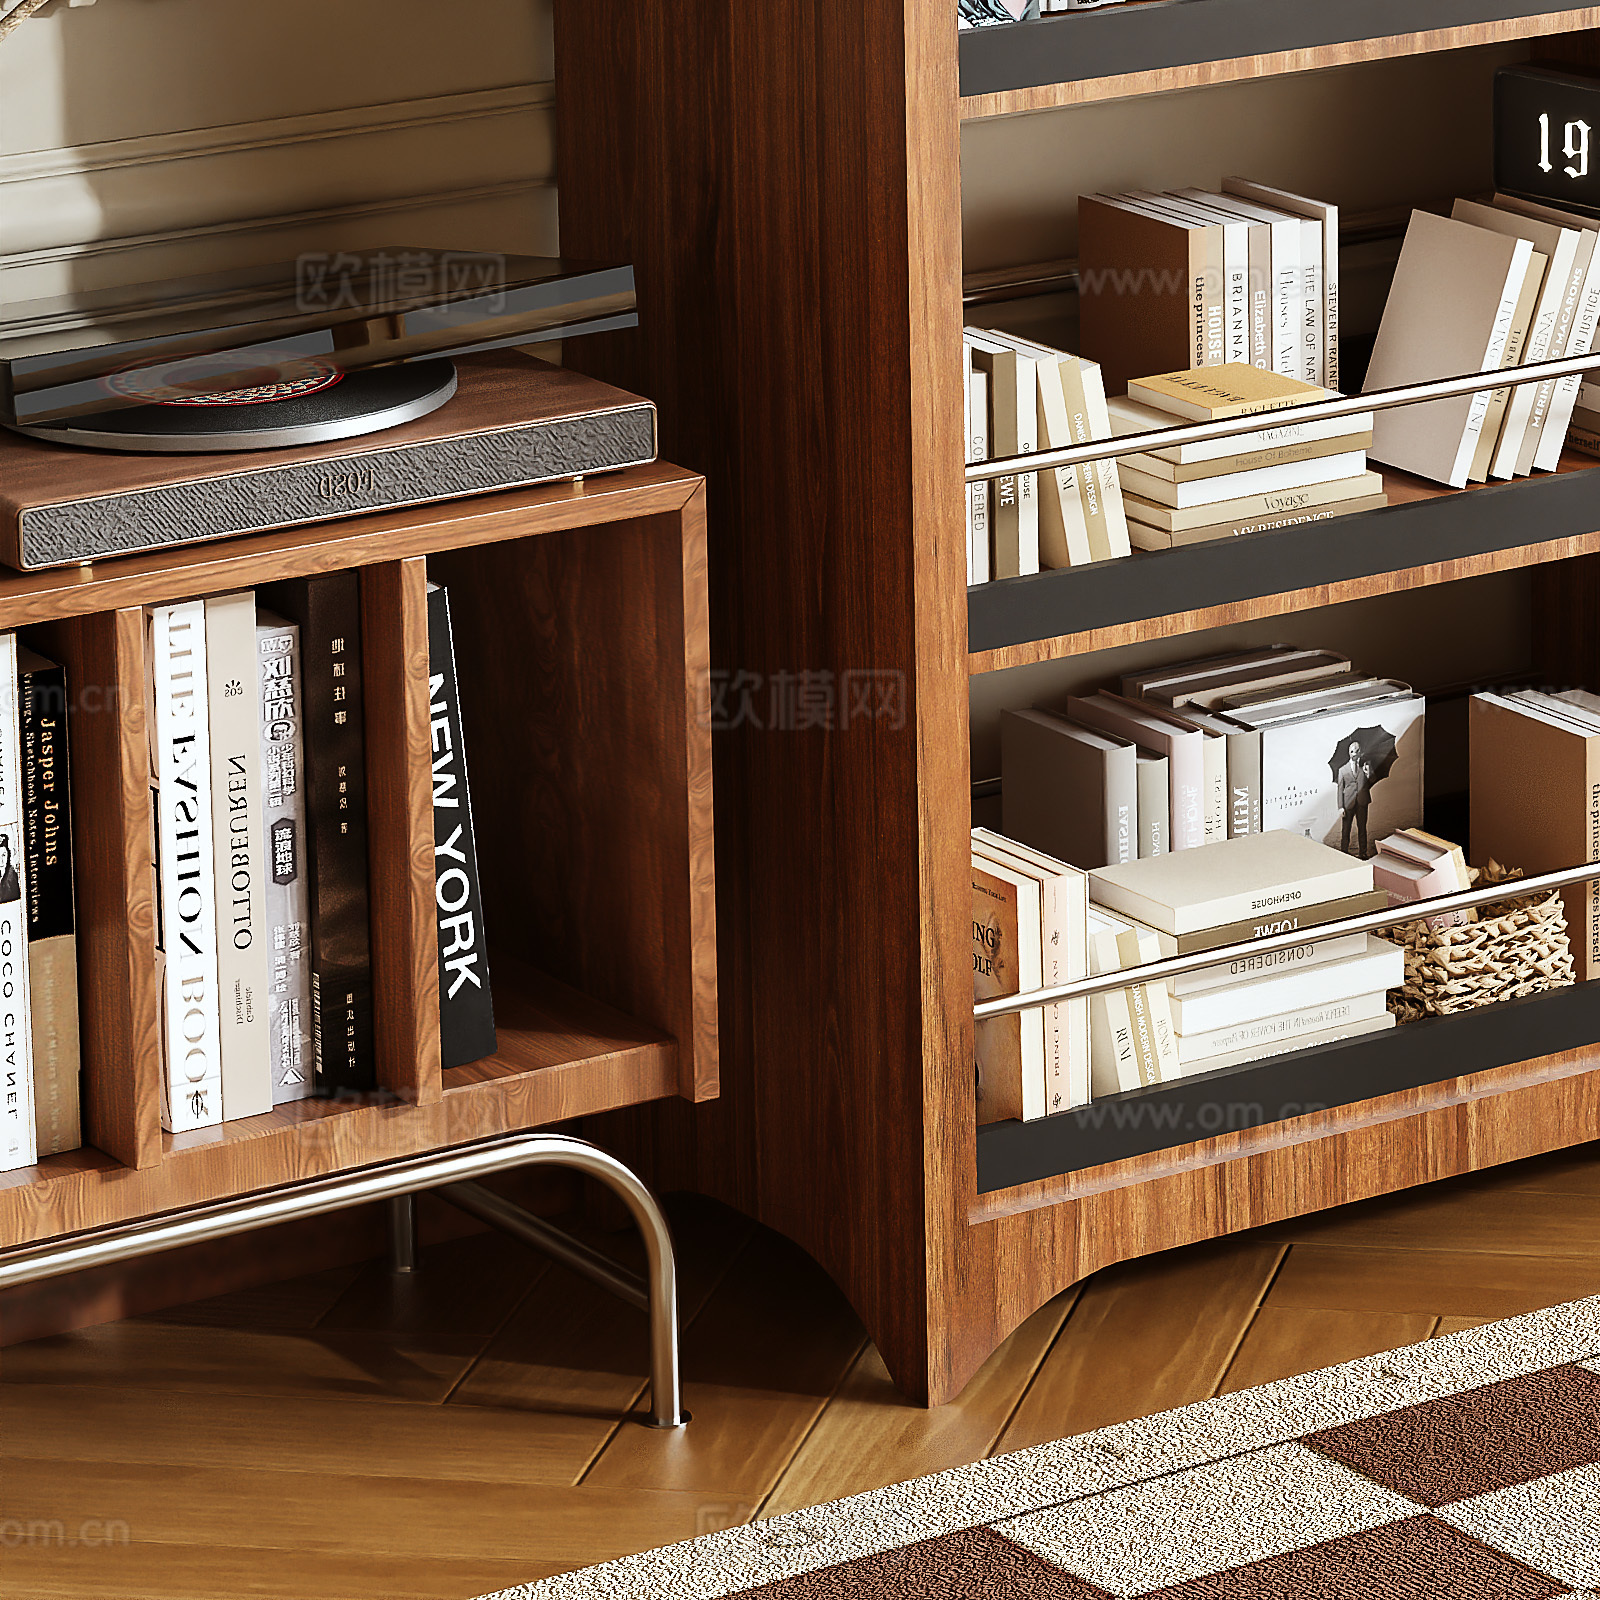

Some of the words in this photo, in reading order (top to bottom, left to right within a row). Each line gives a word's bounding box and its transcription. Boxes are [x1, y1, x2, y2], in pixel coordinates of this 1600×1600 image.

[1195, 276, 1204, 301] the
[1305, 264, 1315, 294] THE
[1232, 273, 1243, 359] BRIANNA
[1254, 290, 1267, 356] Elizabeth
[1305, 299, 1315, 328] LAW
[1327, 283, 1337, 330] STEVEN
[1555, 267, 1583, 345] MACARONS
[1579, 287, 1600, 336] JUSTICE
[1193, 303, 1205, 367] princess
[1208, 305, 1222, 360] HOUSE
[1305, 332, 1316, 350] OF
[1328, 334, 1337, 342] R
[1256, 425, 1304, 442] MAGAZINE
[1568, 430, 1600, 451] herself
[1235, 454, 1263, 467] House
[1264, 452, 1277, 461] Of
[1085, 483, 1099, 516] DESIGN
[1264, 492, 1310, 512] Voyage
[38, 718, 56, 792] Jasper
[429, 672, 460, 809] NEW
[25, 732, 36, 804] Sketchbook
[1592, 783, 1600, 808] the
[44, 799, 60, 867] Johns
[30, 853, 40, 923] Interviews
[434, 823, 482, 1001] YORK
[1131, 983, 1144, 1015] DANISH
[1116, 1027, 1132, 1062] RUM
[1136, 1014, 1151, 1052] MODERN
